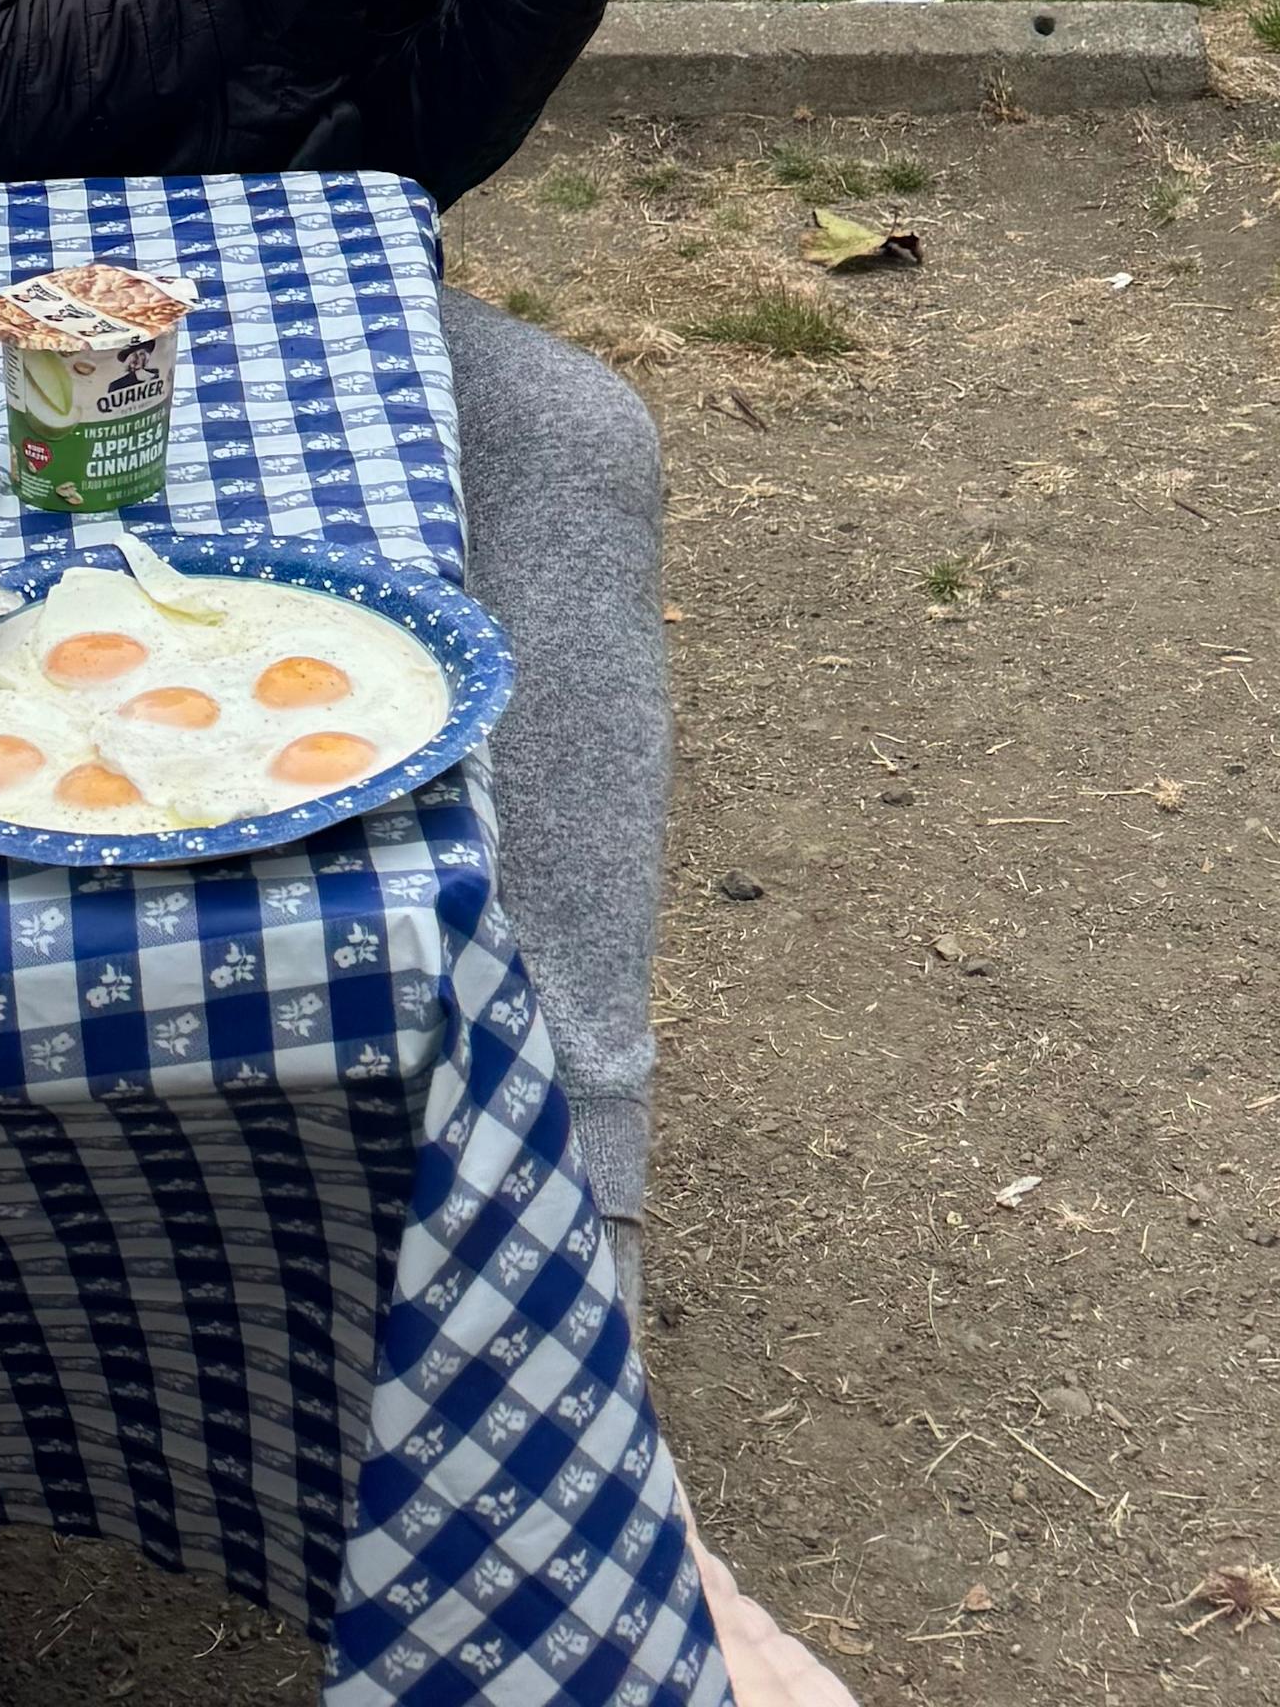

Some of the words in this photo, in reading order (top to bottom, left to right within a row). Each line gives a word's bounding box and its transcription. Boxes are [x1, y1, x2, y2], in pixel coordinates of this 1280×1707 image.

[97, 380, 165, 413] QUAKER
[84, 423, 131, 439] INSTANT
[134, 407, 166, 431] OATMEA
[91, 428, 154, 458] APPLES
[154, 422, 163, 440] &
[86, 439, 164, 478] CINNAMON
